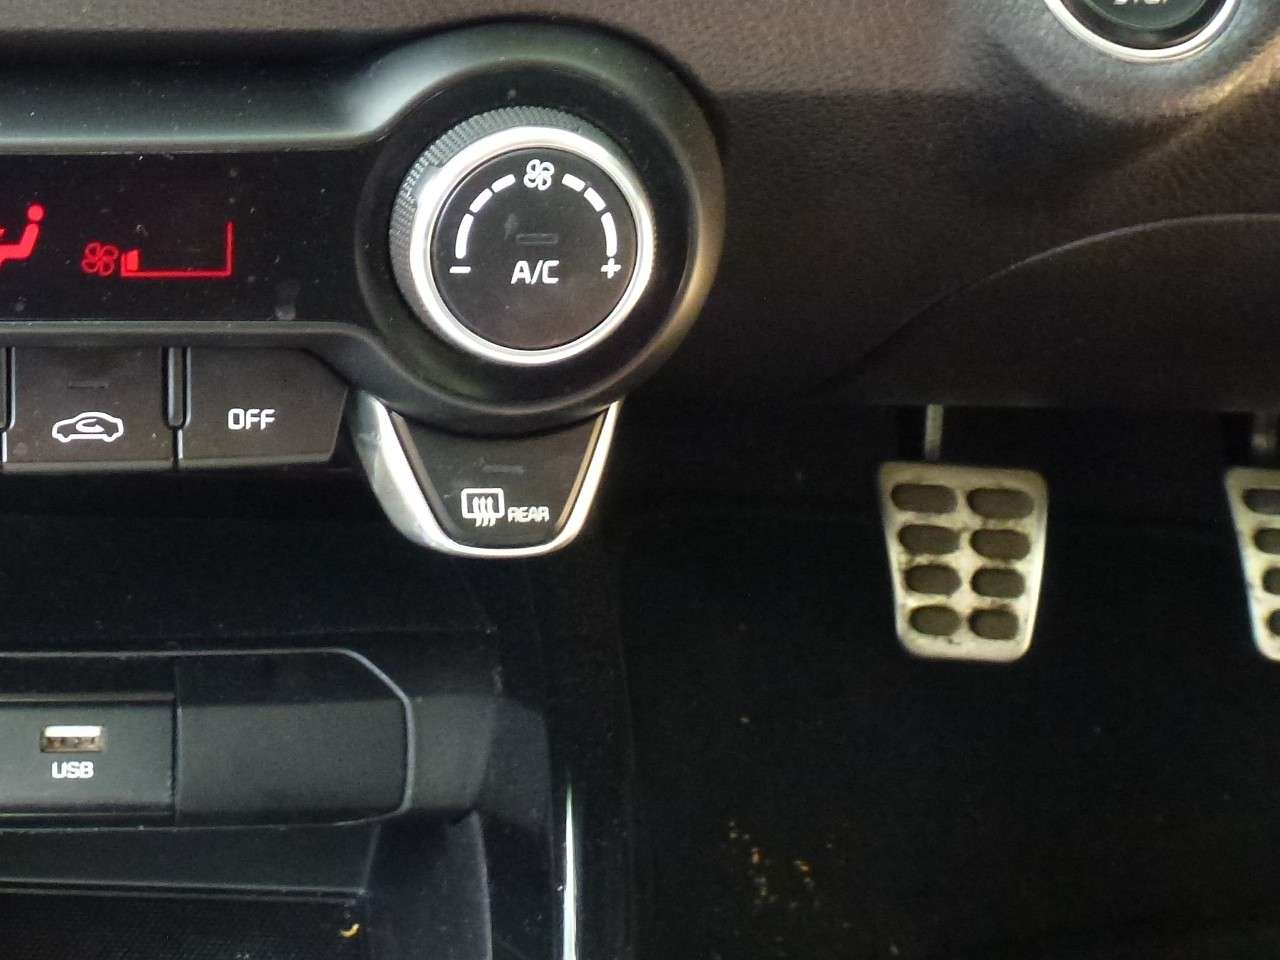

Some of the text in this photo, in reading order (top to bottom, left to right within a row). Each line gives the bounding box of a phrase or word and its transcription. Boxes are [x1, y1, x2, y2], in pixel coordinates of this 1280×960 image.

[510, 259, 560, 285] A/C
[227, 408, 276, 431] OFF
[507, 506, 550, 523] REAR
[51, 761, 95, 779] USB
